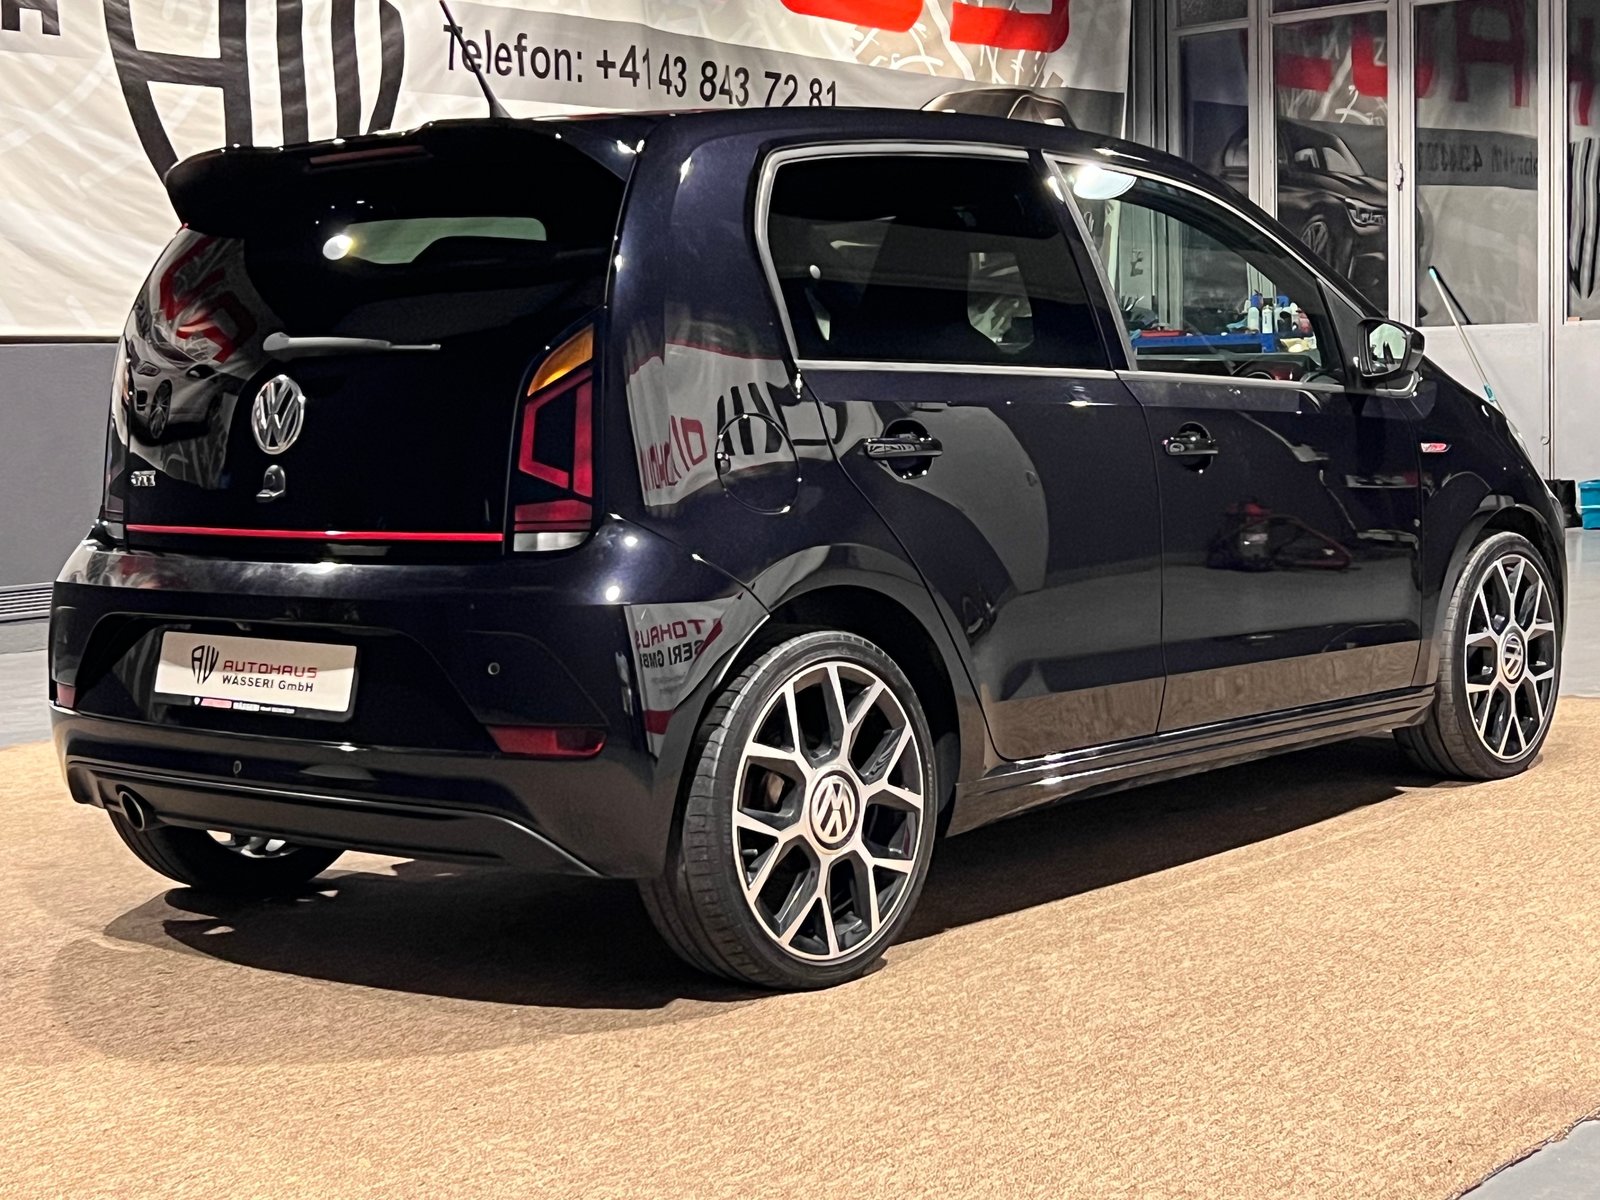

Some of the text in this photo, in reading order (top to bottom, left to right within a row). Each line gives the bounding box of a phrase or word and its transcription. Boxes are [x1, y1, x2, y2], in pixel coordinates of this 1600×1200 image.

[443, 24, 582, 83] Telefon:
[699, 60, 750, 107] 843
[764, 70, 799, 107] 72
[808, 77, 837, 107] 81
[222, 660, 318, 679] AUTOHAUS
[278, 680, 314, 692] GmbH
